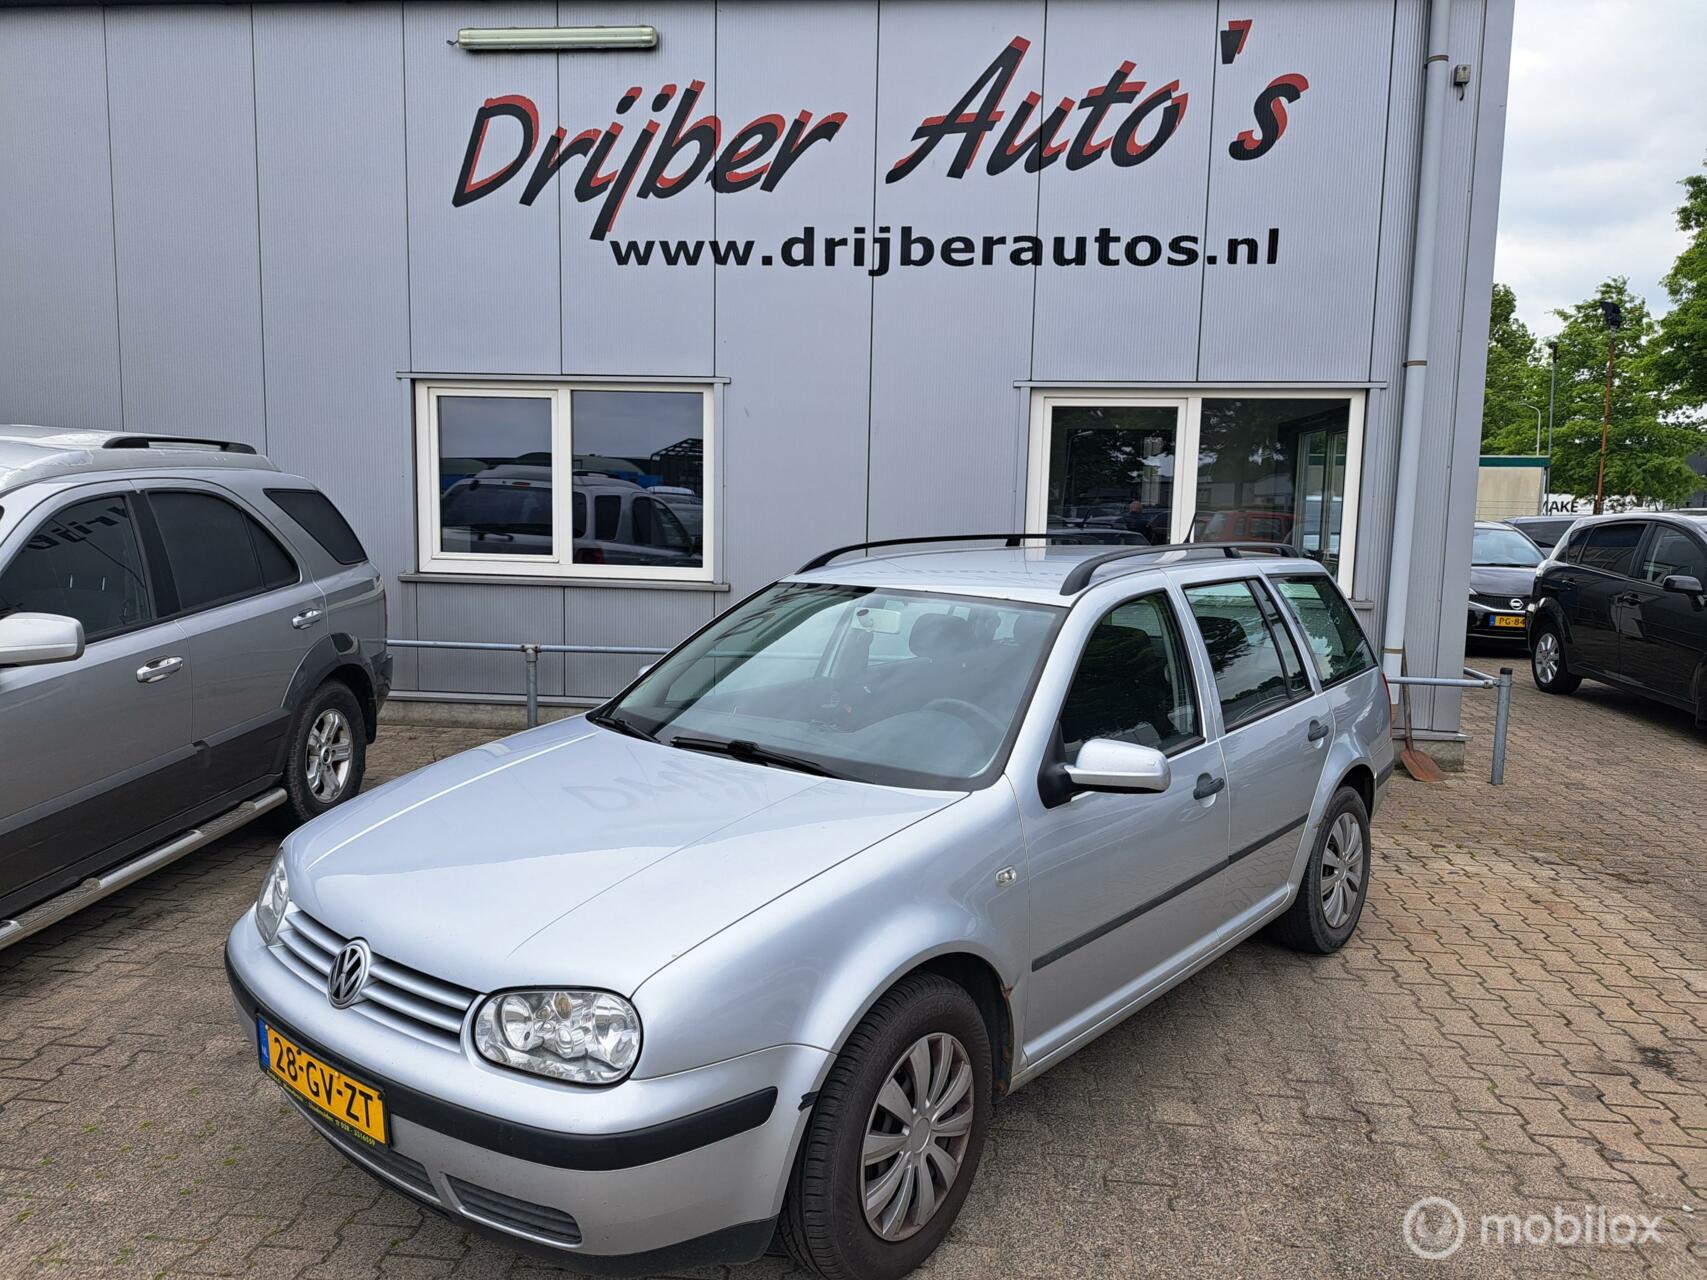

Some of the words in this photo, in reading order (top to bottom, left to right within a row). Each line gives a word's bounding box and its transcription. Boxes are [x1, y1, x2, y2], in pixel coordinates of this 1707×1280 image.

[452, 80, 848, 241] Drijber
[885, 19, 1309, 184] Auto's
[610, 226, 1280, 277] www.drijberautos.nl
[274, 1037, 374, 1128] 28-GV-ZT
